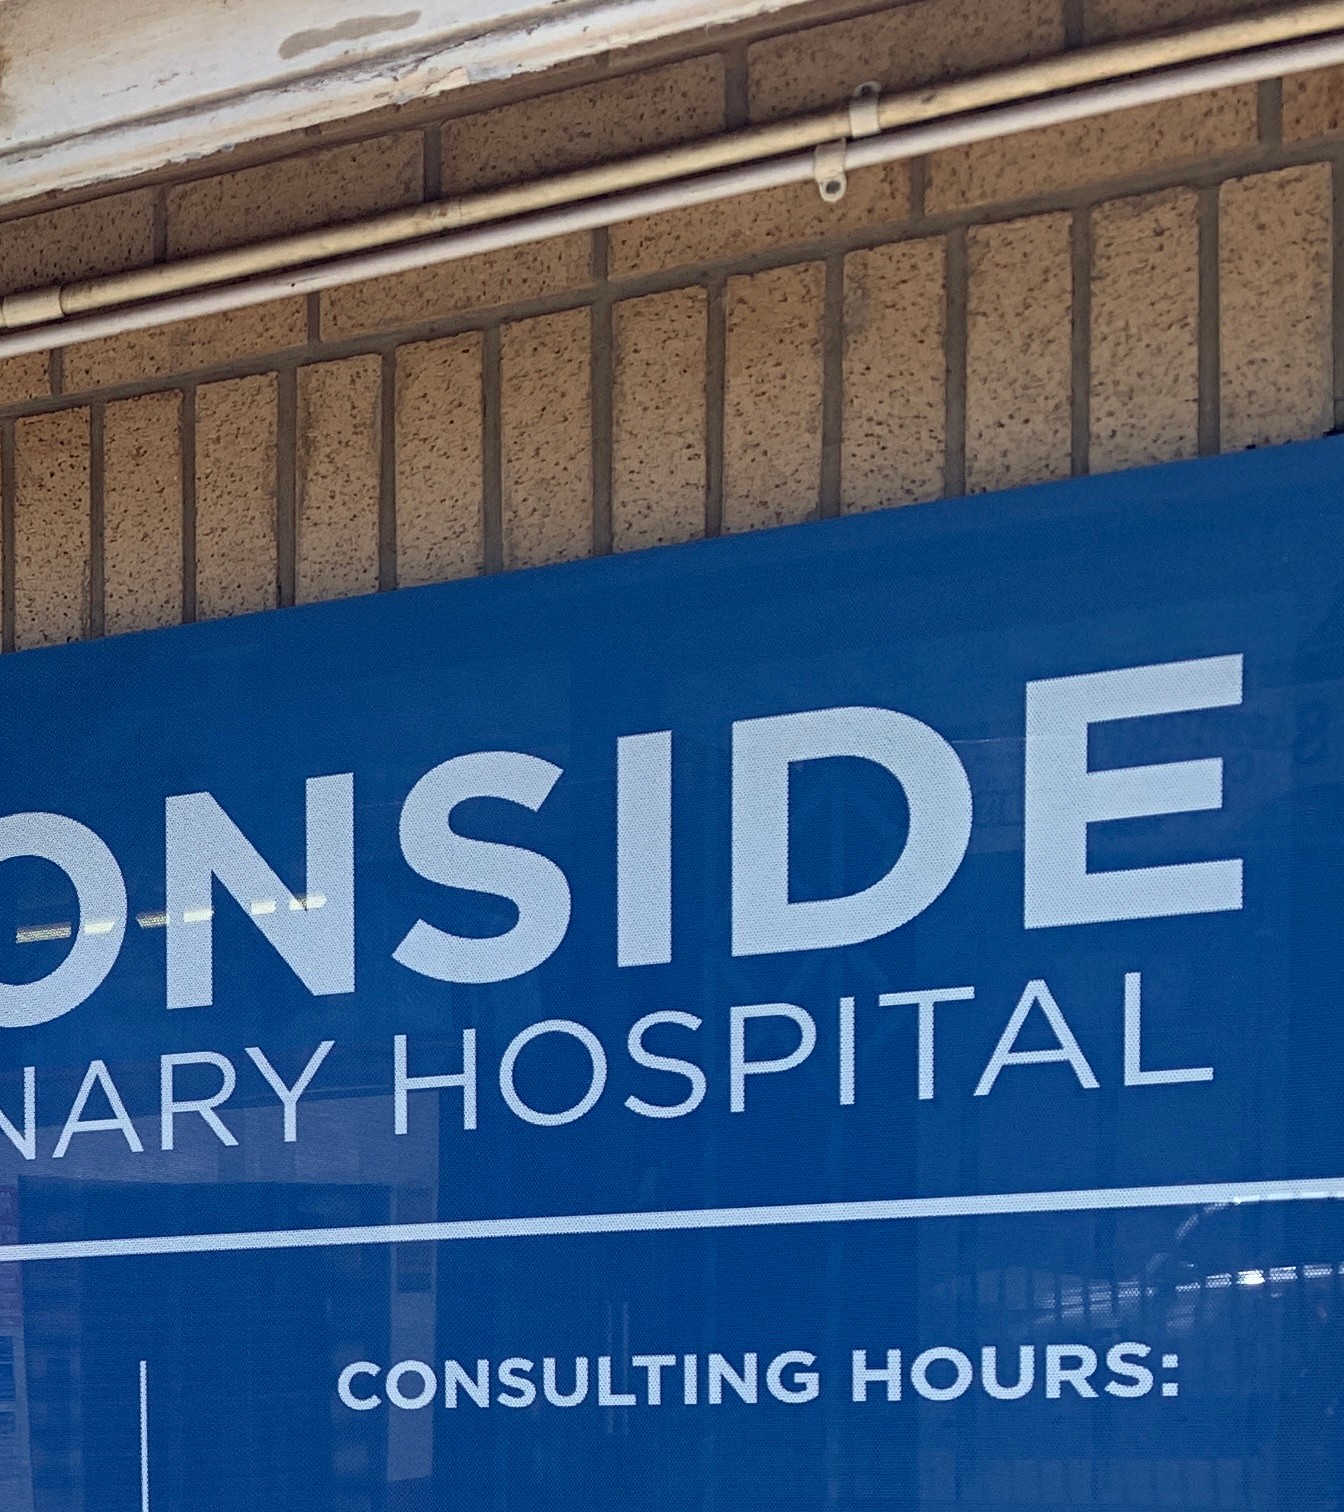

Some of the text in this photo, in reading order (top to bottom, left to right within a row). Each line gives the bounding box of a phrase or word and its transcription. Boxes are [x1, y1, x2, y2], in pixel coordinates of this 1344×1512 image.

[395, 973, 1212, 1134] HOSPITAL
[339, 1343, 1177, 1409] CONSULTING HOURS:
